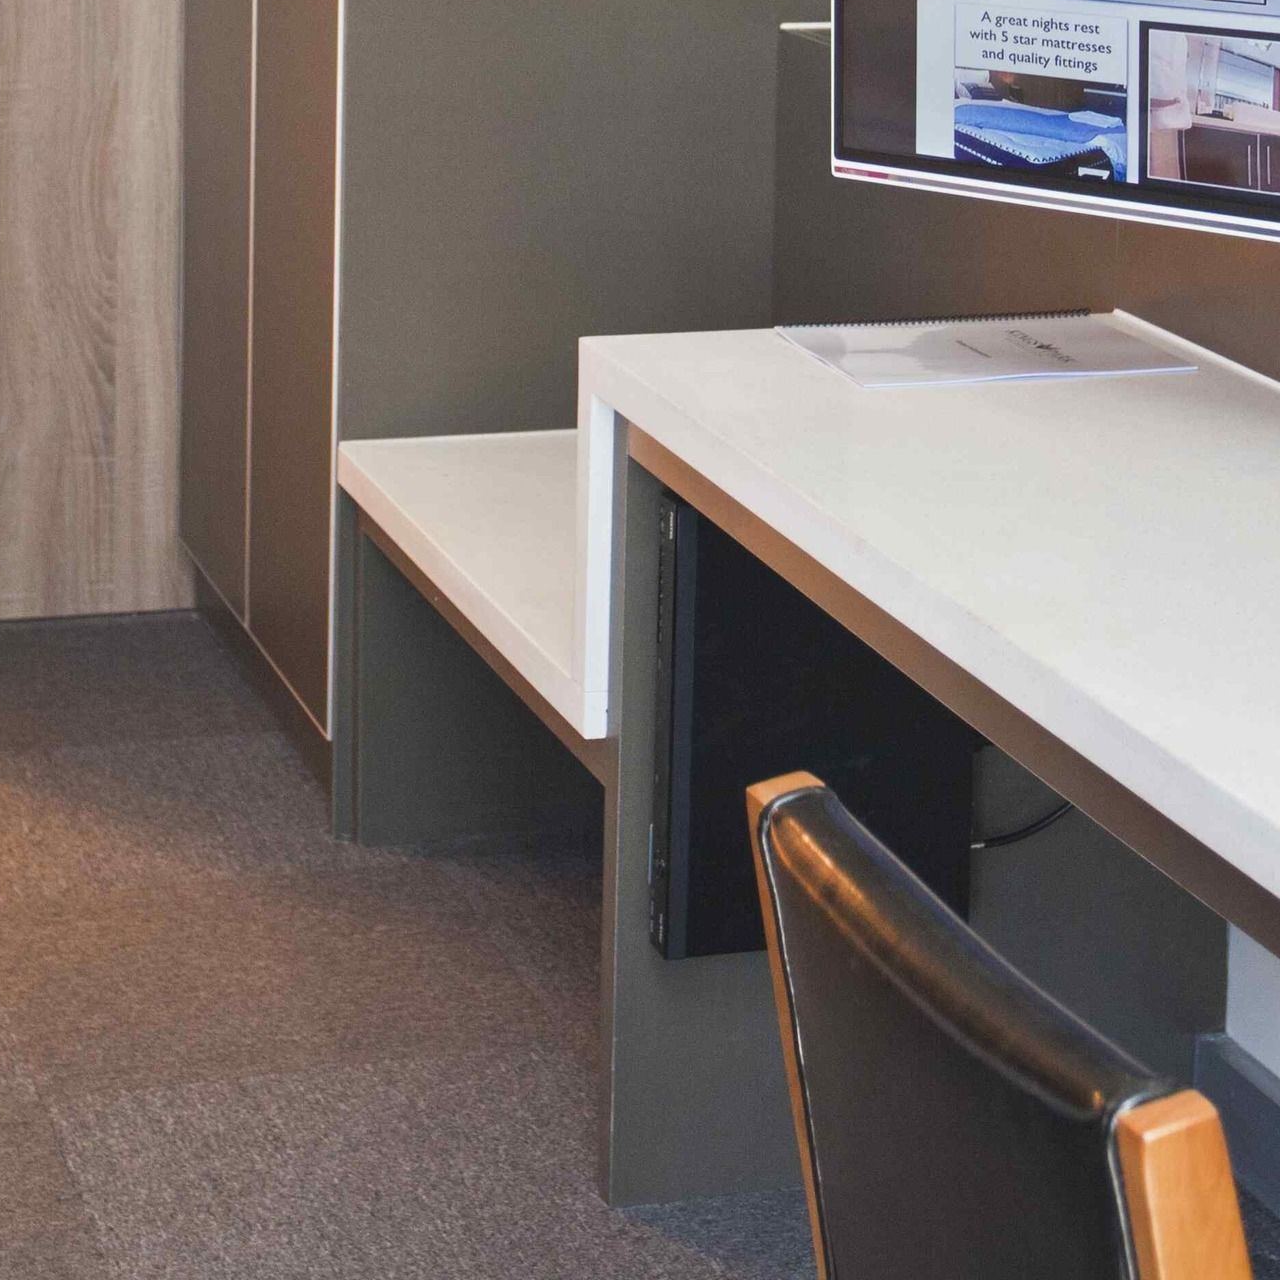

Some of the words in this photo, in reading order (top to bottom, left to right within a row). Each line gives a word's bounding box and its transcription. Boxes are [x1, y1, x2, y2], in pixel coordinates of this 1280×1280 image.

[981, 11, 992, 22] A
[995, 16, 1028, 28] great
[1032, 17, 1070, 33] nights
[1074, 23, 1100, 35] rest
[970, 30, 997, 42] with
[1001, 31, 1009, 43] 5
[1013, 35, 1038, 46] star
[1041, 38, 1112, 55] mattresses
[982, 48, 1005, 61] and
[1008, 51, 1051, 69] quality
[1054, 55, 1098, 73] fittings
